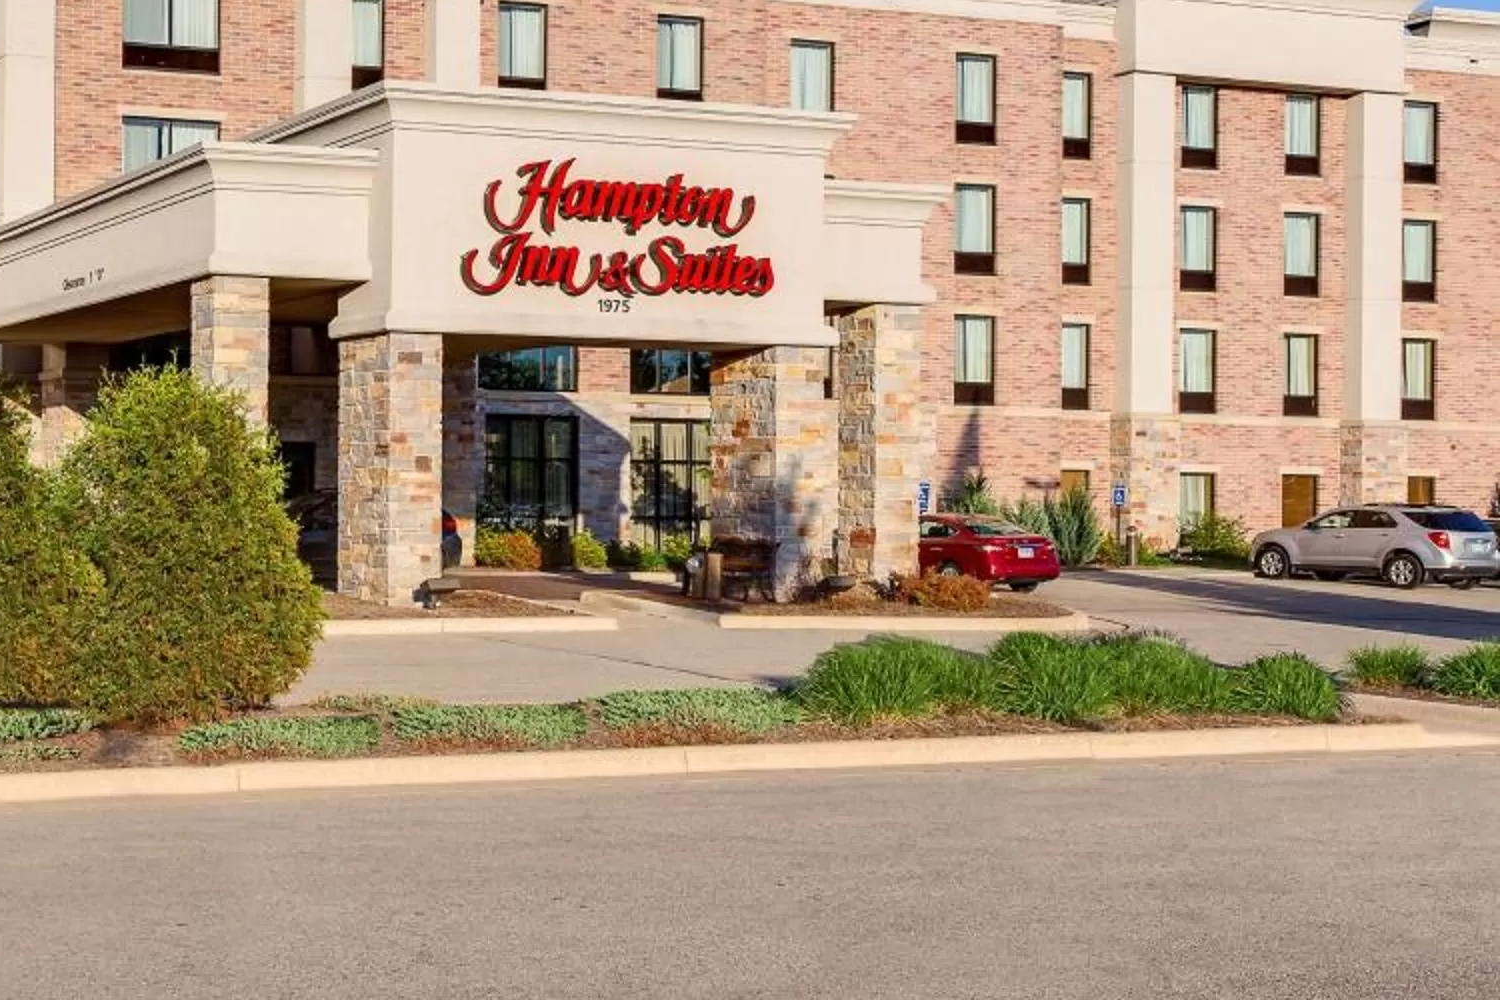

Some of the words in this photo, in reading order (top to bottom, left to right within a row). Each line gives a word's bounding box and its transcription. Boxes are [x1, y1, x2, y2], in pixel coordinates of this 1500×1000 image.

[483, 157, 756, 237] Hampton
[460, 231, 603, 296] Inn
[598, 251, 638, 298] &
[629, 235, 775, 297] Suites
[598, 299, 631, 313] 1975
